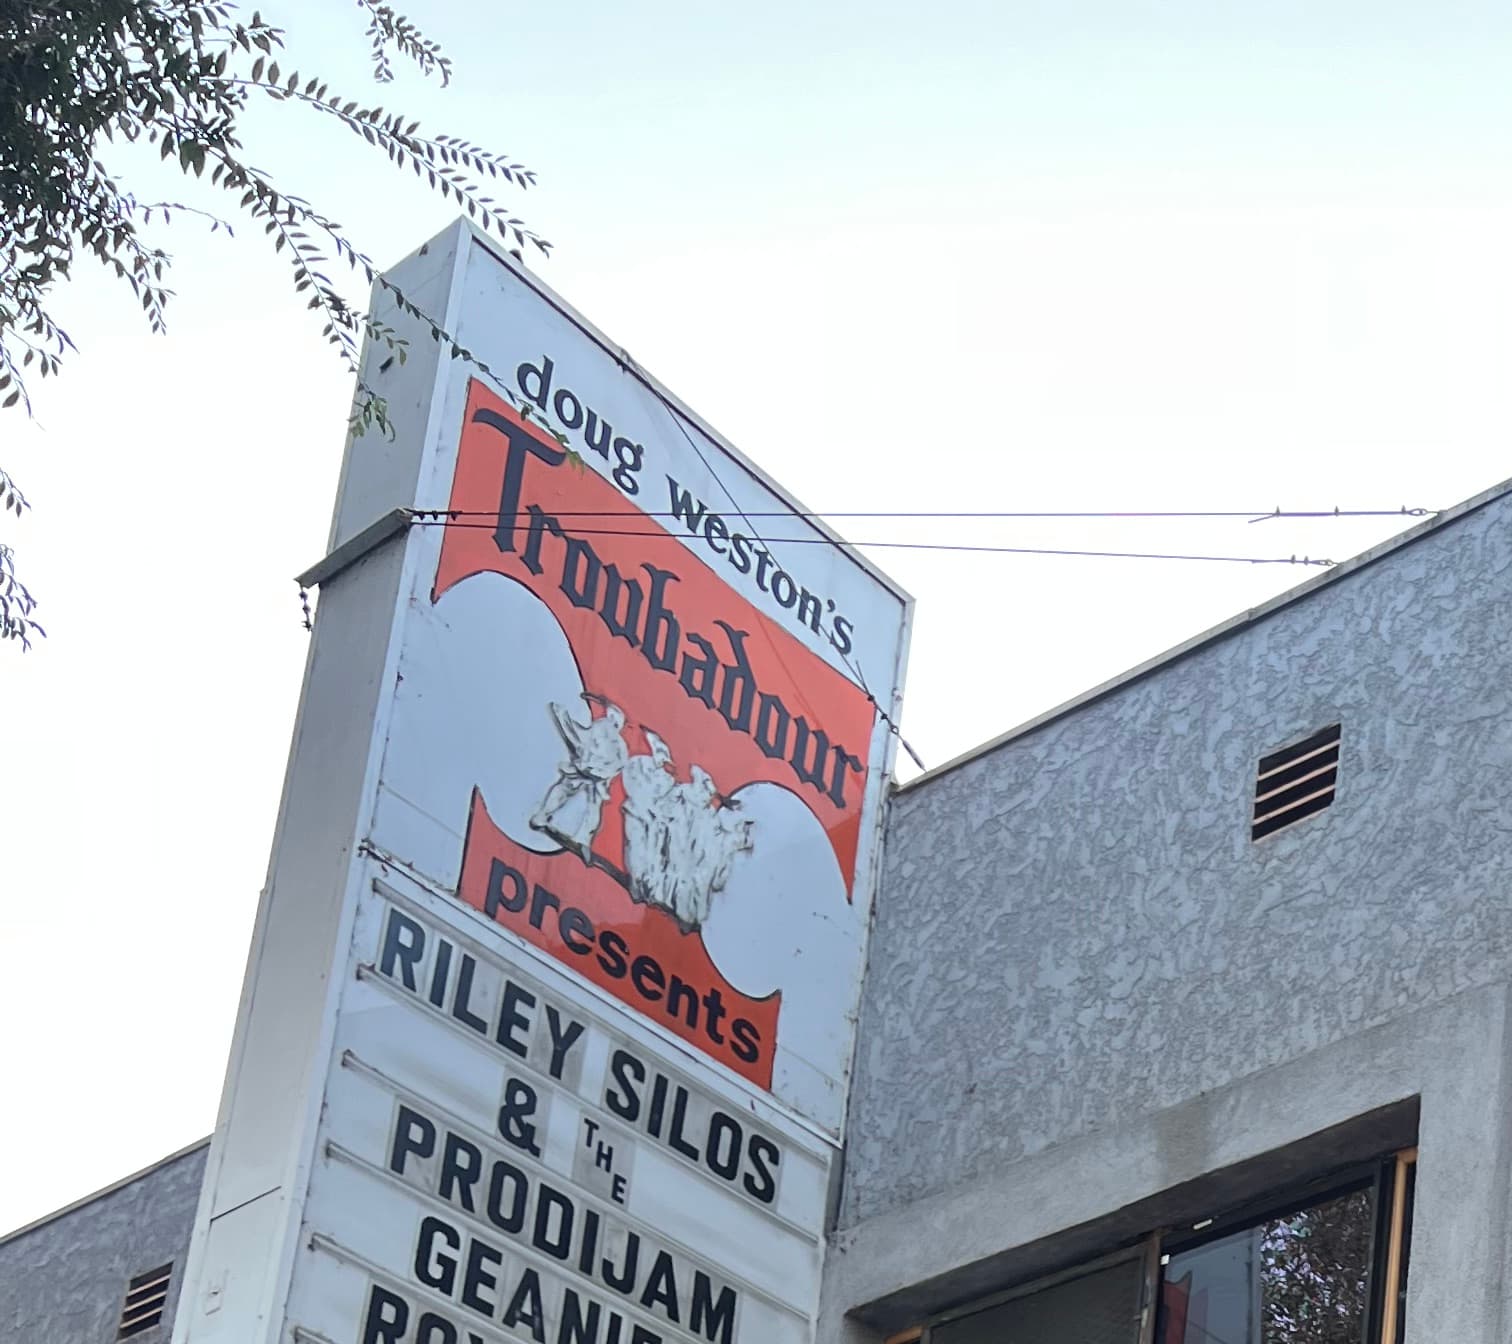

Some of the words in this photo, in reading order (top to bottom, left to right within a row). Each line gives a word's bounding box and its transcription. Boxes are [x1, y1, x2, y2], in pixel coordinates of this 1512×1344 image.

[472, 408, 865, 809] Troubadour
[517, 355, 645, 496] doug
[666, 474, 855, 655] weston's
[380, 907, 585, 1081] RILEY
[605, 1050, 781, 1203] SILOS
[484, 857, 761, 1064] presents
[500, 1077, 542, 1158] &
